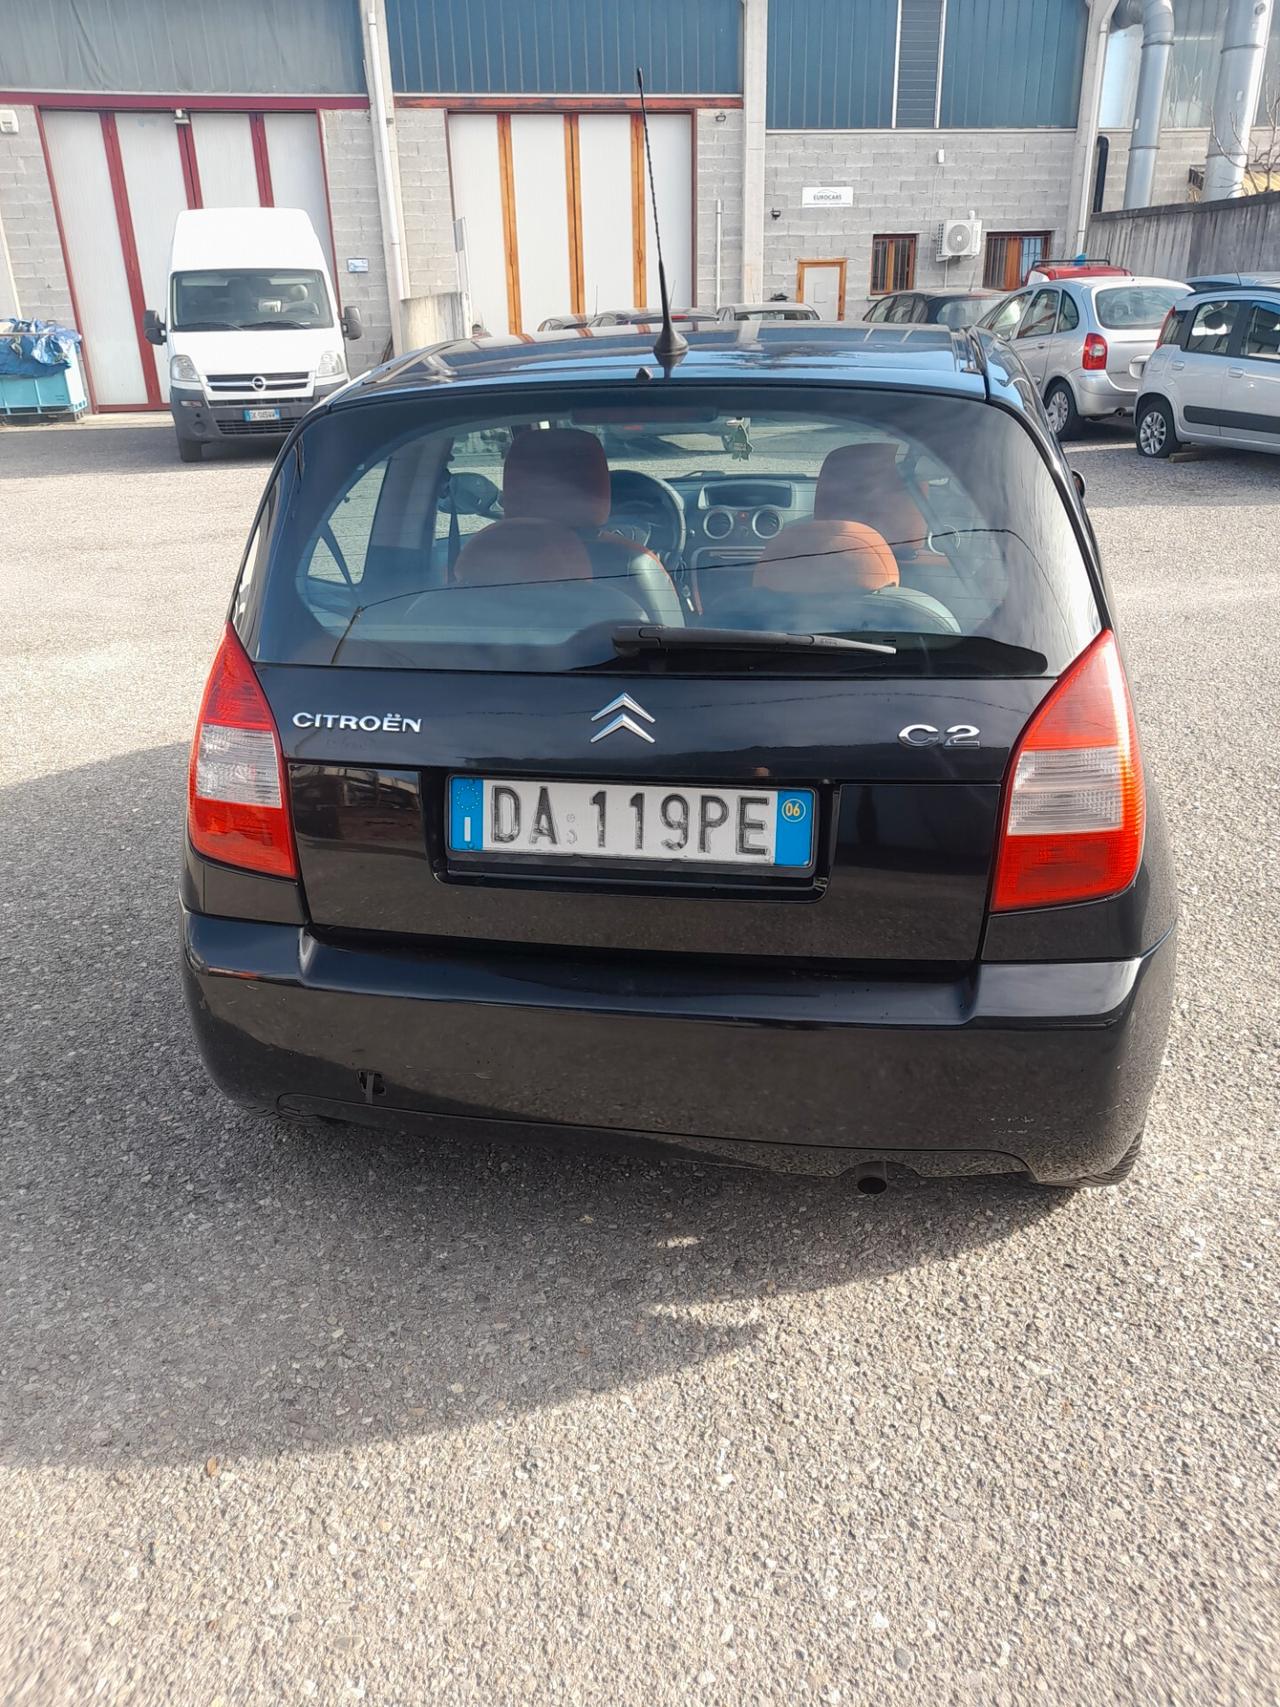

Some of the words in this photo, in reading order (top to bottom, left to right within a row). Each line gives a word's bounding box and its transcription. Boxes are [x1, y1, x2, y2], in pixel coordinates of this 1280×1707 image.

[292, 712, 422, 733] CITROËN
[898, 724, 980, 748] C2
[785, 803, 801, 817] 06
